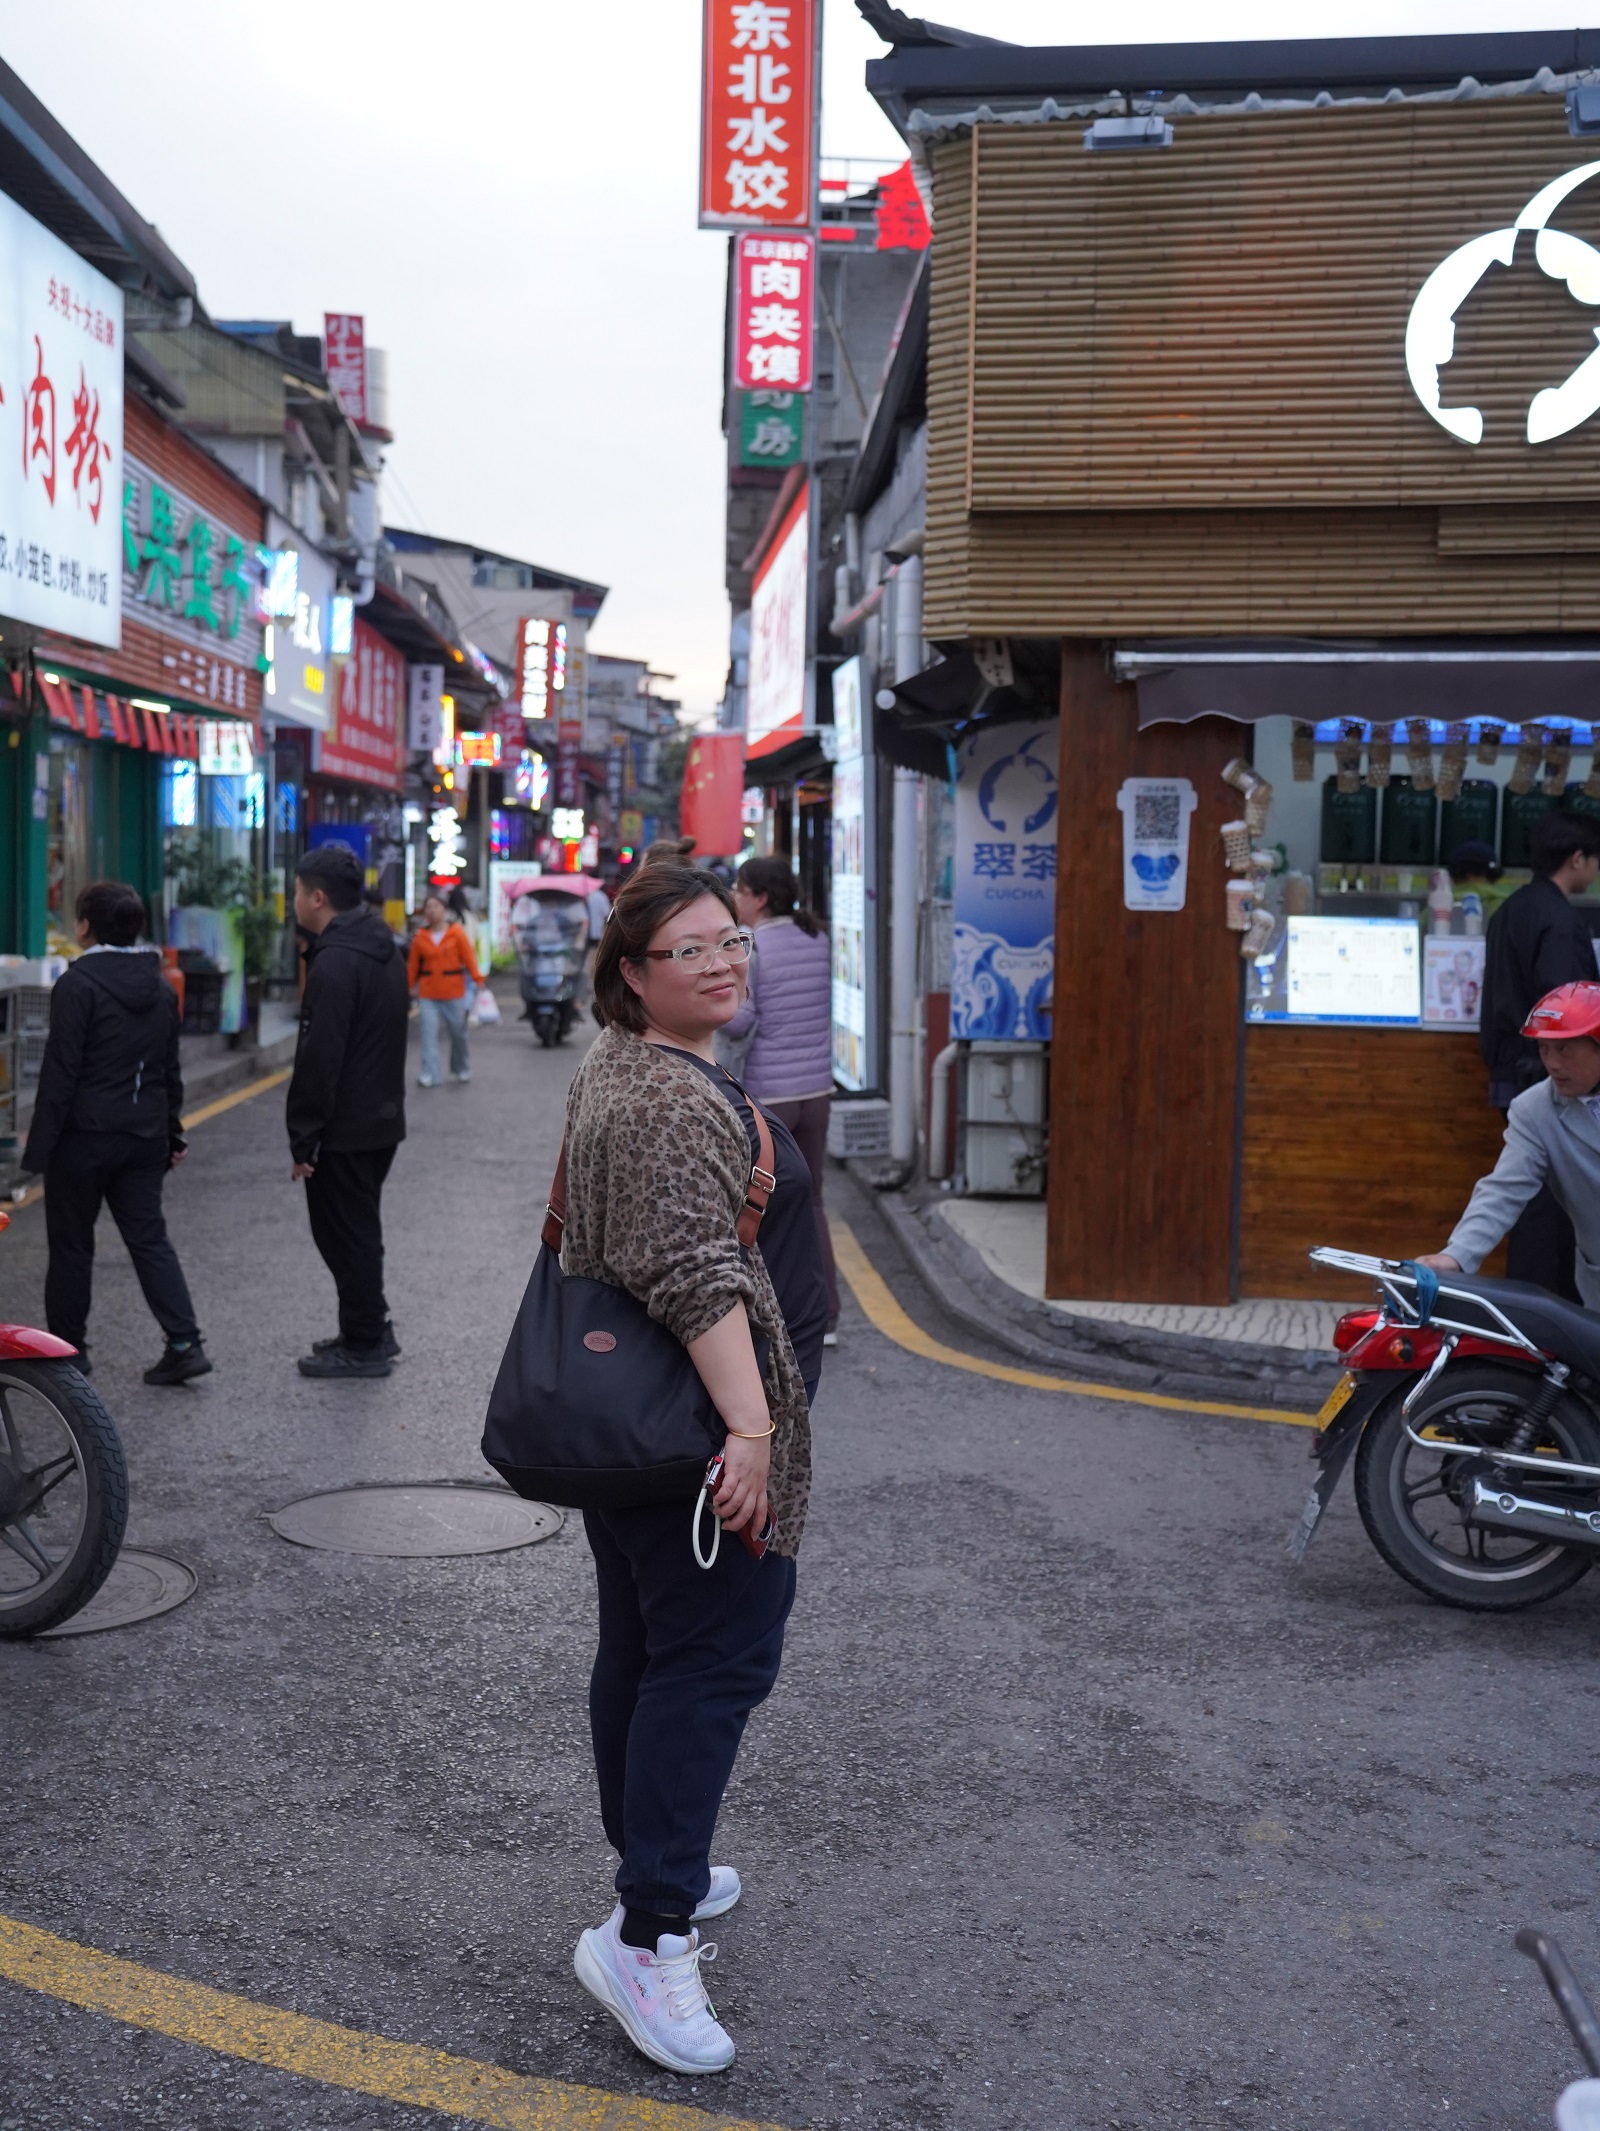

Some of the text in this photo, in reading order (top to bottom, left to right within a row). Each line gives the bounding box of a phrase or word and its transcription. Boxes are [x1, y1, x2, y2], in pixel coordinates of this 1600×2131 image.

[725, 0, 792, 210] 东北水饺
[743, 239, 808, 262] 正宗西安
[746, 260, 802, 384] 肉夹馍
[0, 334, 112, 525] 肉粉
[986, 889, 1044, 900] CUICHA
